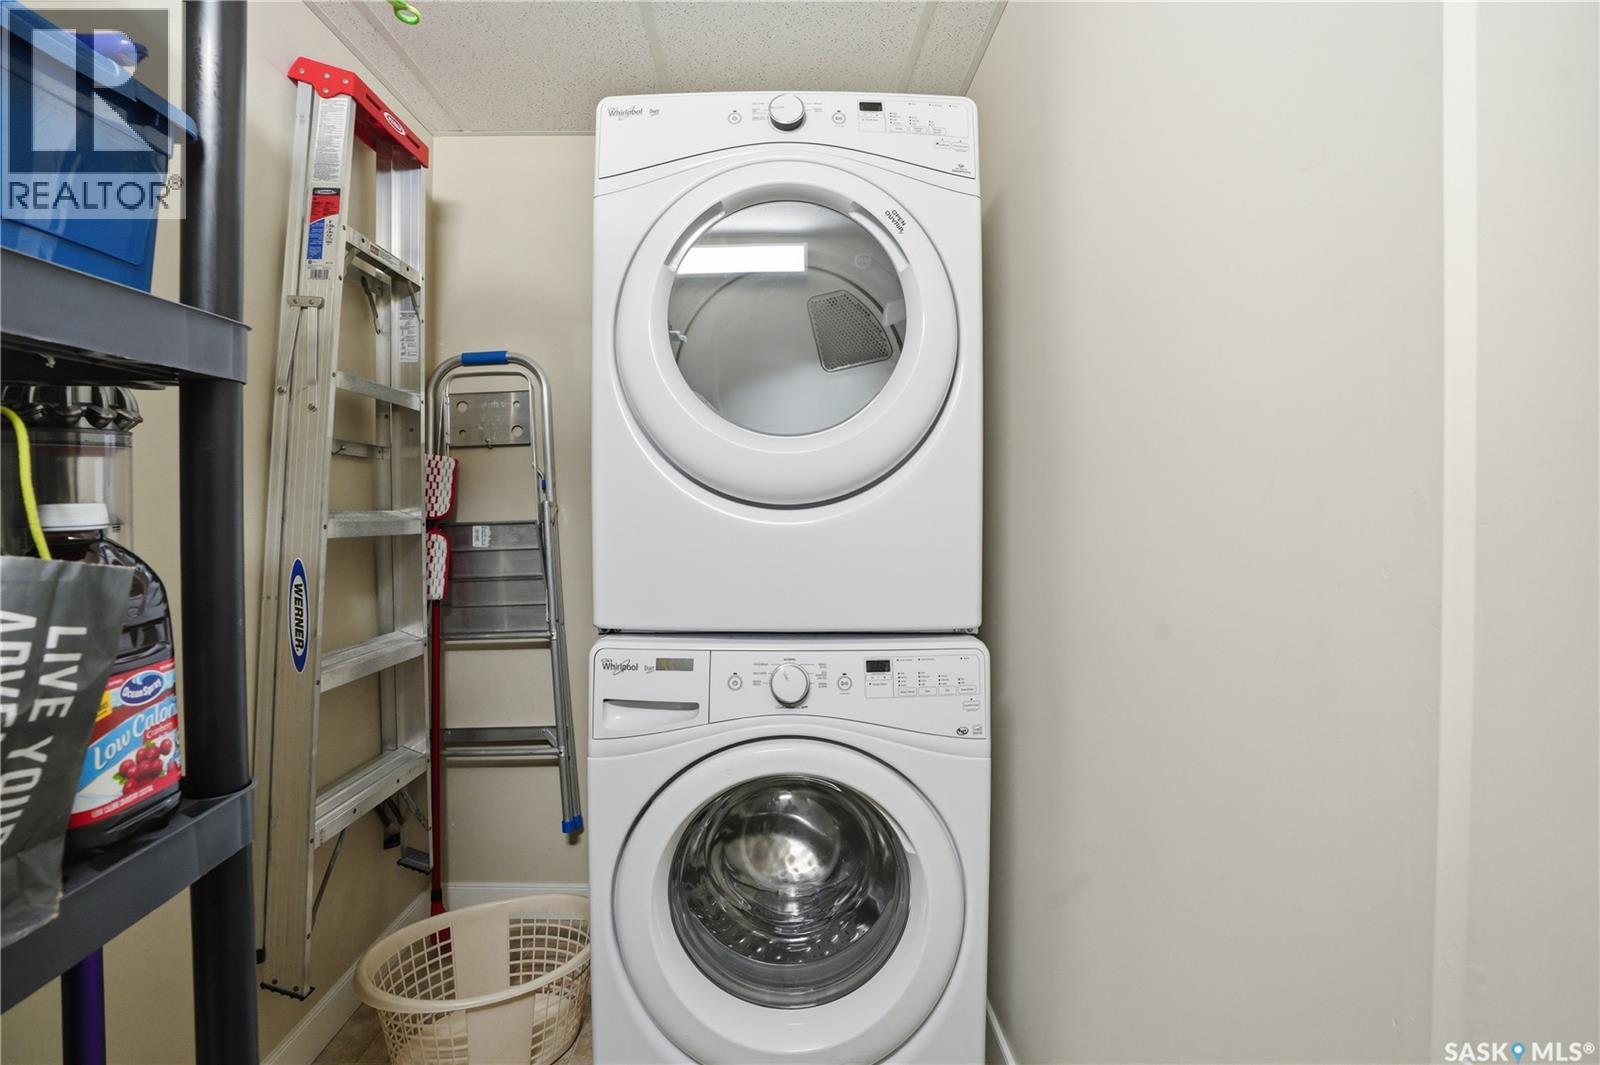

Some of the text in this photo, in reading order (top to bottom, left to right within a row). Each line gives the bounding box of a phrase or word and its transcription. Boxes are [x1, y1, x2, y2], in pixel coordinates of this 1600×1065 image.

[293, 583, 304, 650] WERNER
[28, 626, 88, 722] LIVE
[601, 660, 639, 673] Whirlpool
[93, 730, 131, 771] Low
